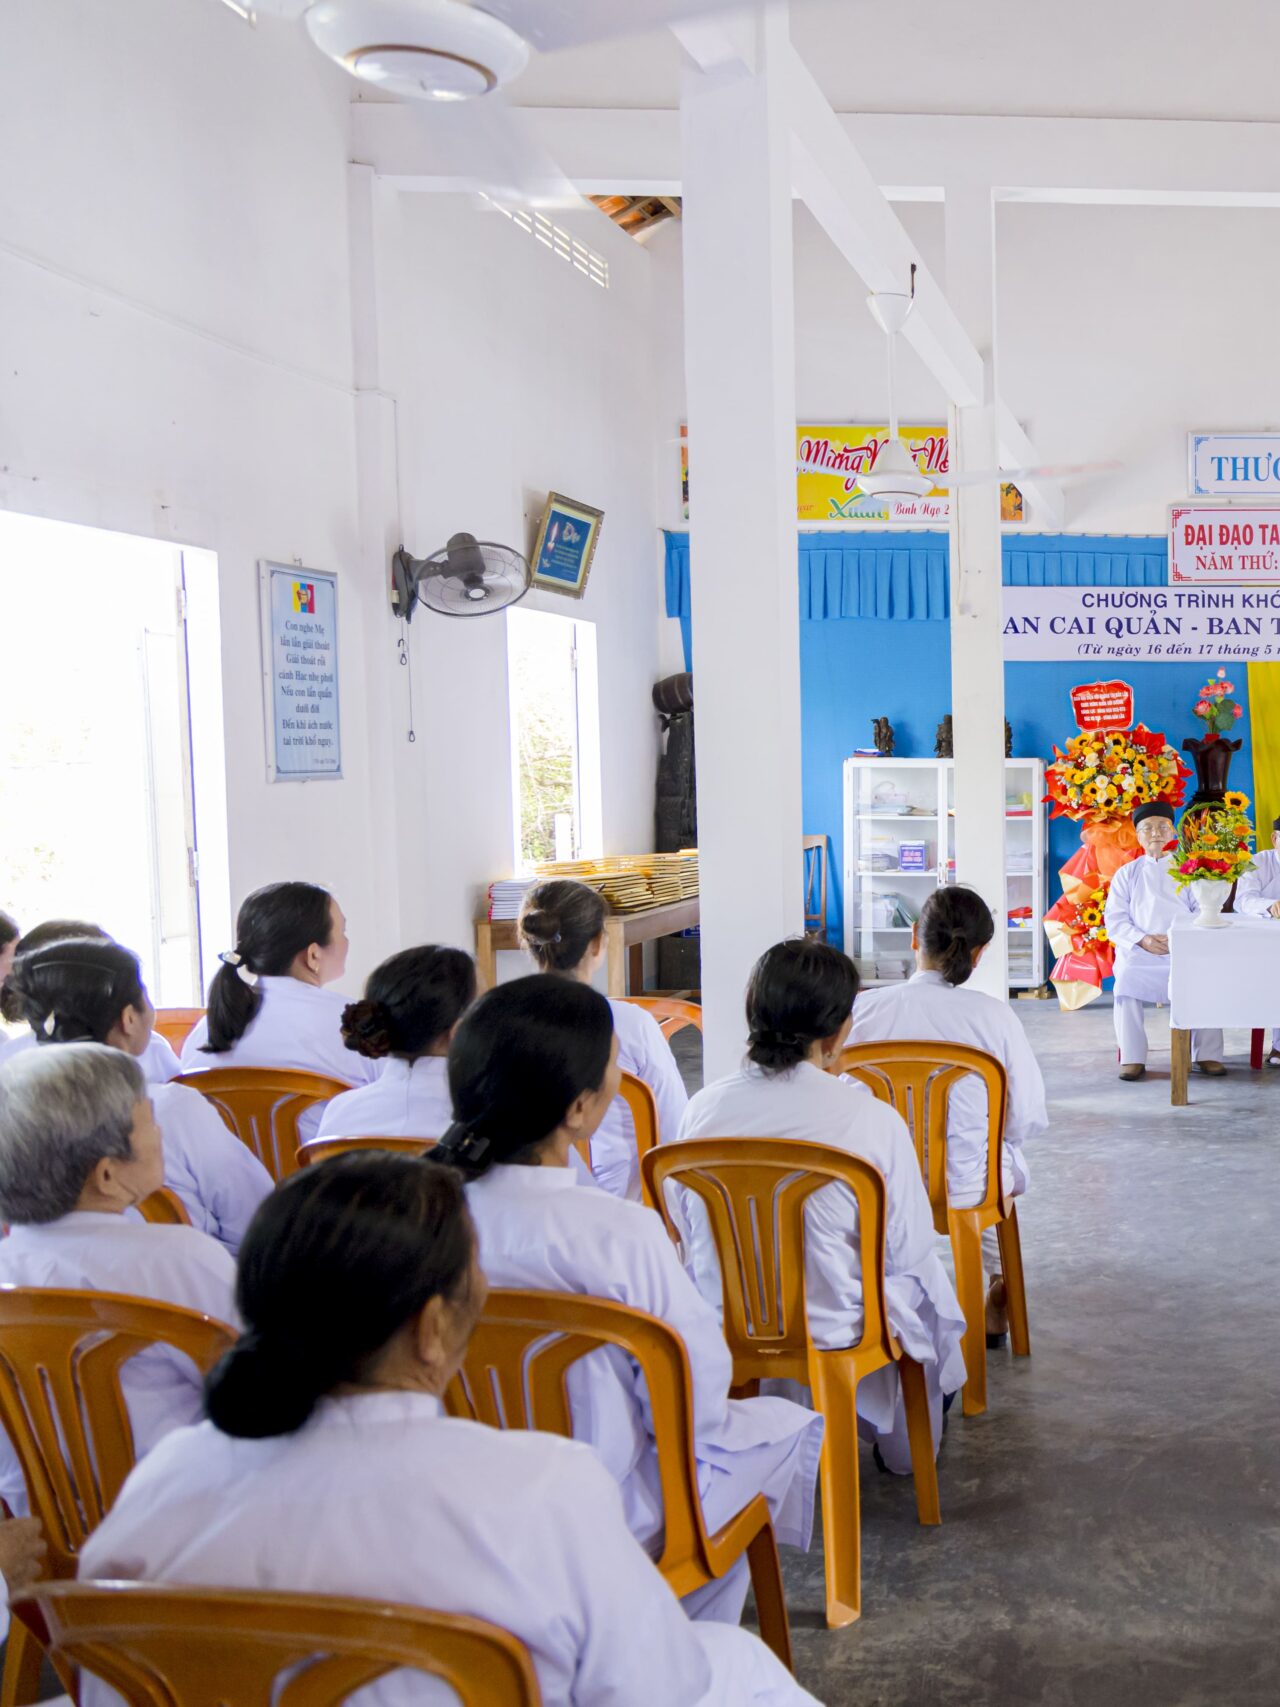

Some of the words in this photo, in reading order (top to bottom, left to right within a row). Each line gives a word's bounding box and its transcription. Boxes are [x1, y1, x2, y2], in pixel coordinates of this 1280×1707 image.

[1184, 523, 1213, 549] ĐẠI
[1218, 524, 1255, 549] ĐẠO
[1195, 552, 1235, 570] NĂM
[1239, 550, 1279, 570] THỨ:
[1082, 592, 1168, 608] CHƯƠNG
[1174, 590, 1234, 608] TRÌNH
[286, 621, 298, 631] Con
[1050, 616, 1096, 635] CAI
[1105, 610, 1182, 638] QUẢN
[1207, 618, 1262, 635] BAN
[1078, 644, 1103, 654] (Từ
[1107, 644, 1141, 656] ngày
[1147, 644, 1162, 654] 16
[1166, 643, 1192, 654] đến
[1198, 644, 1213, 654] 17
[1218, 644, 1260, 656] tháng
[1264, 644, 1272, 654] 5
